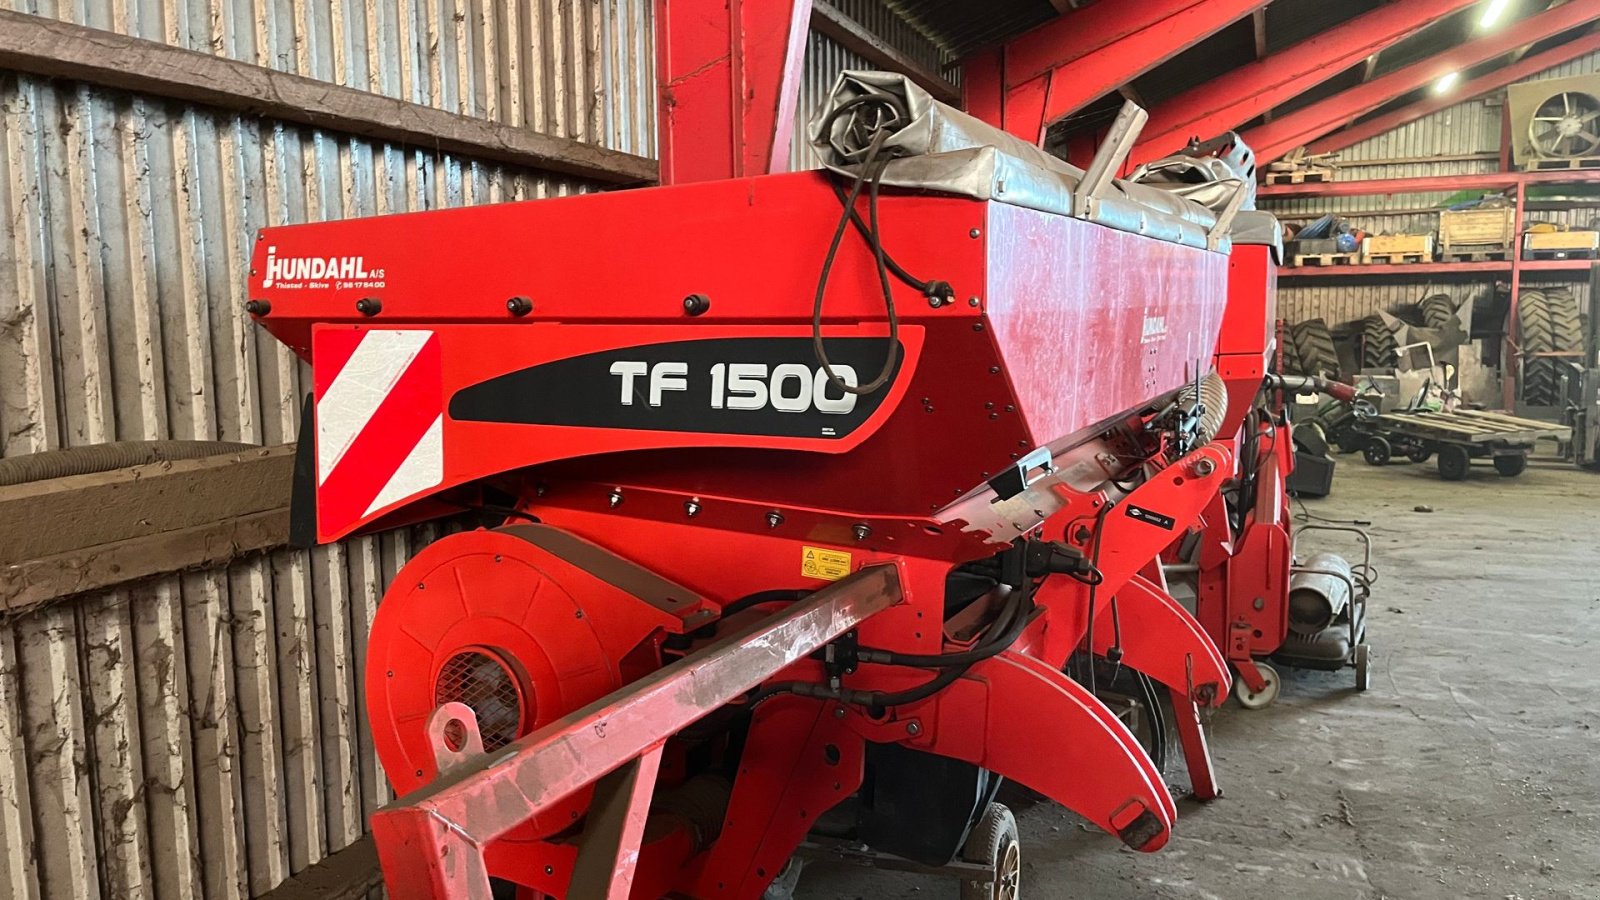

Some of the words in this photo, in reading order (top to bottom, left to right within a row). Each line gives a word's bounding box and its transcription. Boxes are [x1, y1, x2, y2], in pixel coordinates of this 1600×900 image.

[369, 269, 385, 278] A/S
[609, 361, 688, 407] TF
[710, 362, 858, 415] 1500
